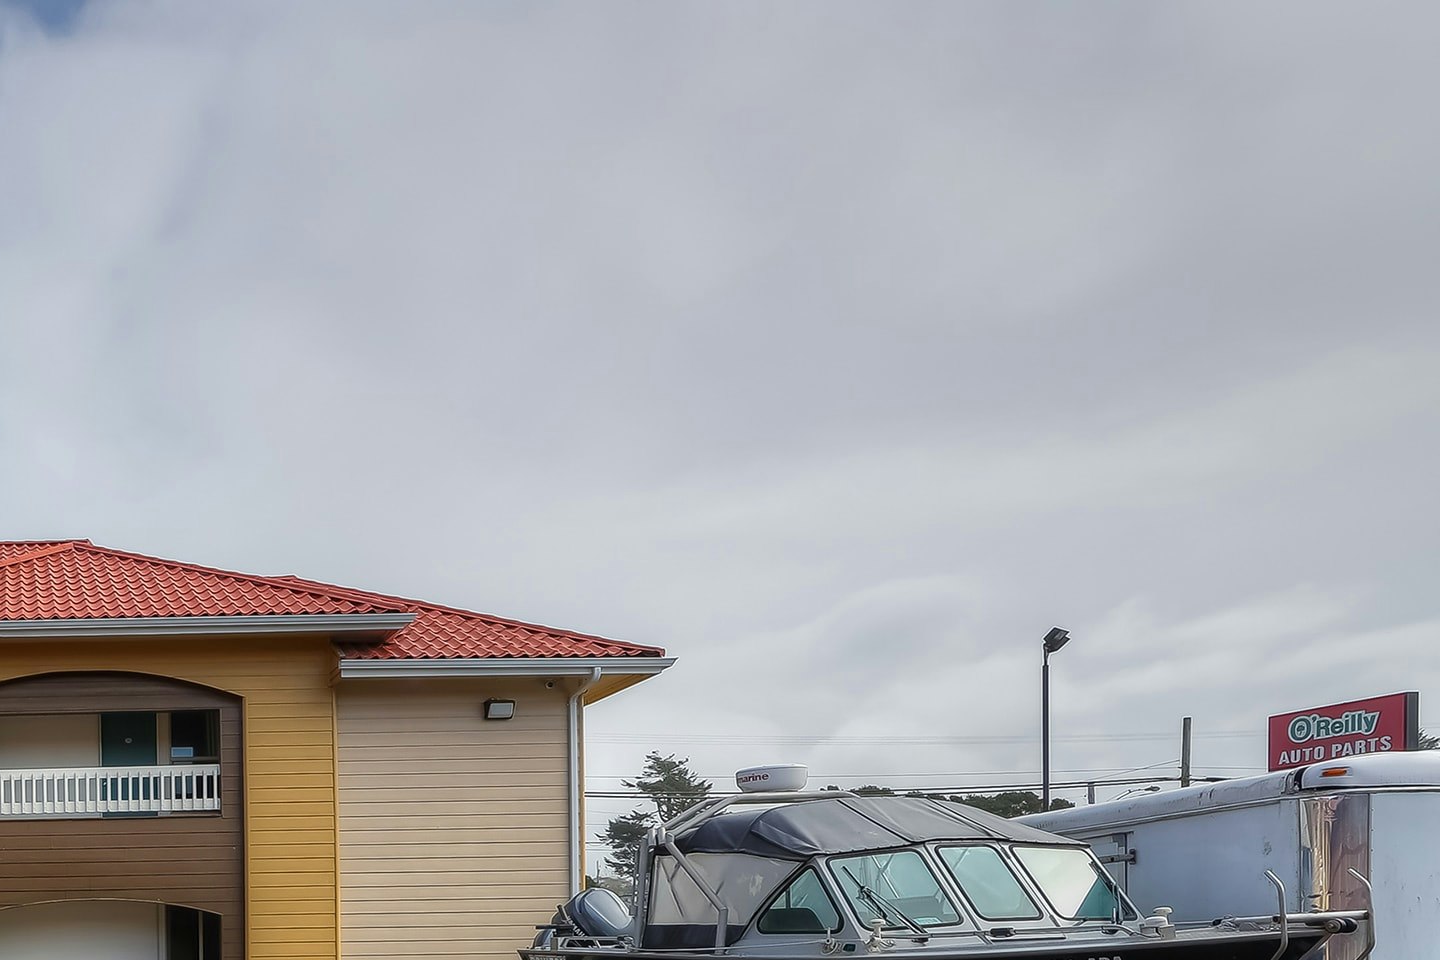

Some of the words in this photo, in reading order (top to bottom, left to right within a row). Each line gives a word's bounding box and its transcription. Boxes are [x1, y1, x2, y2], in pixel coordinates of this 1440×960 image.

[1288, 711, 1380, 743] O'Reilly
[1279, 745, 1324, 765] AUTO
[1331, 736, 1392, 758] PARTS
